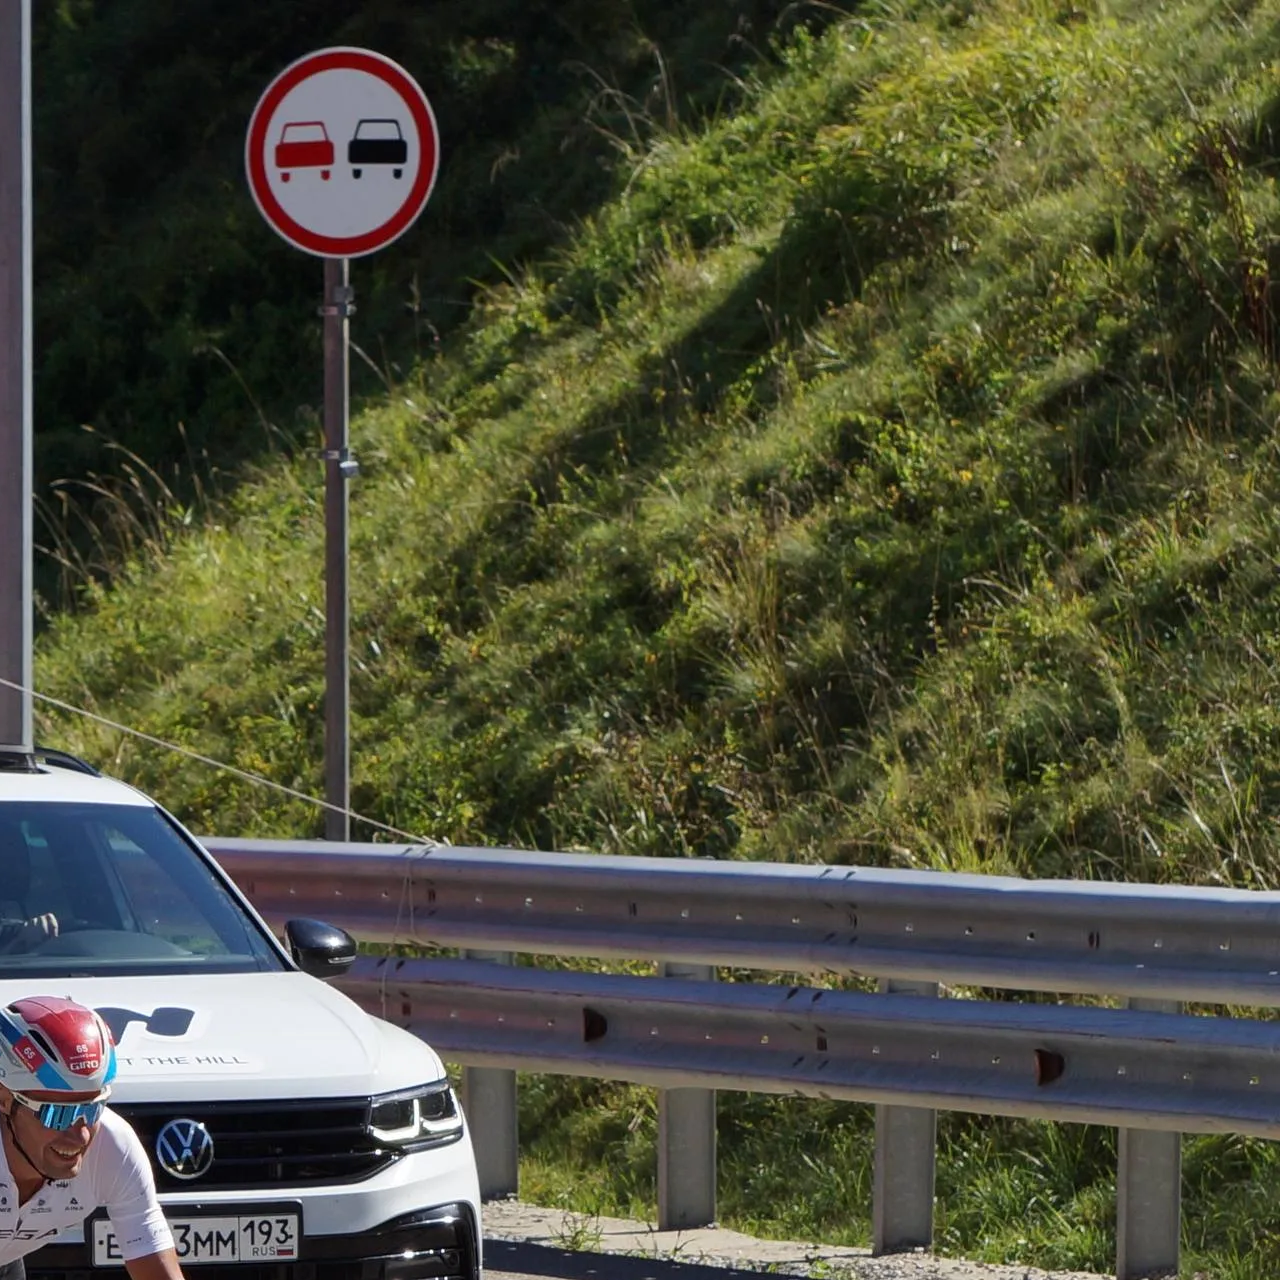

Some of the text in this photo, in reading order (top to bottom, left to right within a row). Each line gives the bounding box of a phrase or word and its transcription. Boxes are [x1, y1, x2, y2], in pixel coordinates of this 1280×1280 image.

[23, 1046, 36, 1060] 65
[76, 1044, 89, 1053] 65
[70, 1060, 99, 1070] GIRO
[140, 1056, 189, 1066] THE
[198, 1055, 249, 1065] HILL
[242, 1218, 289, 1246] 193
[252, 1247, 276, 1257] RUS
